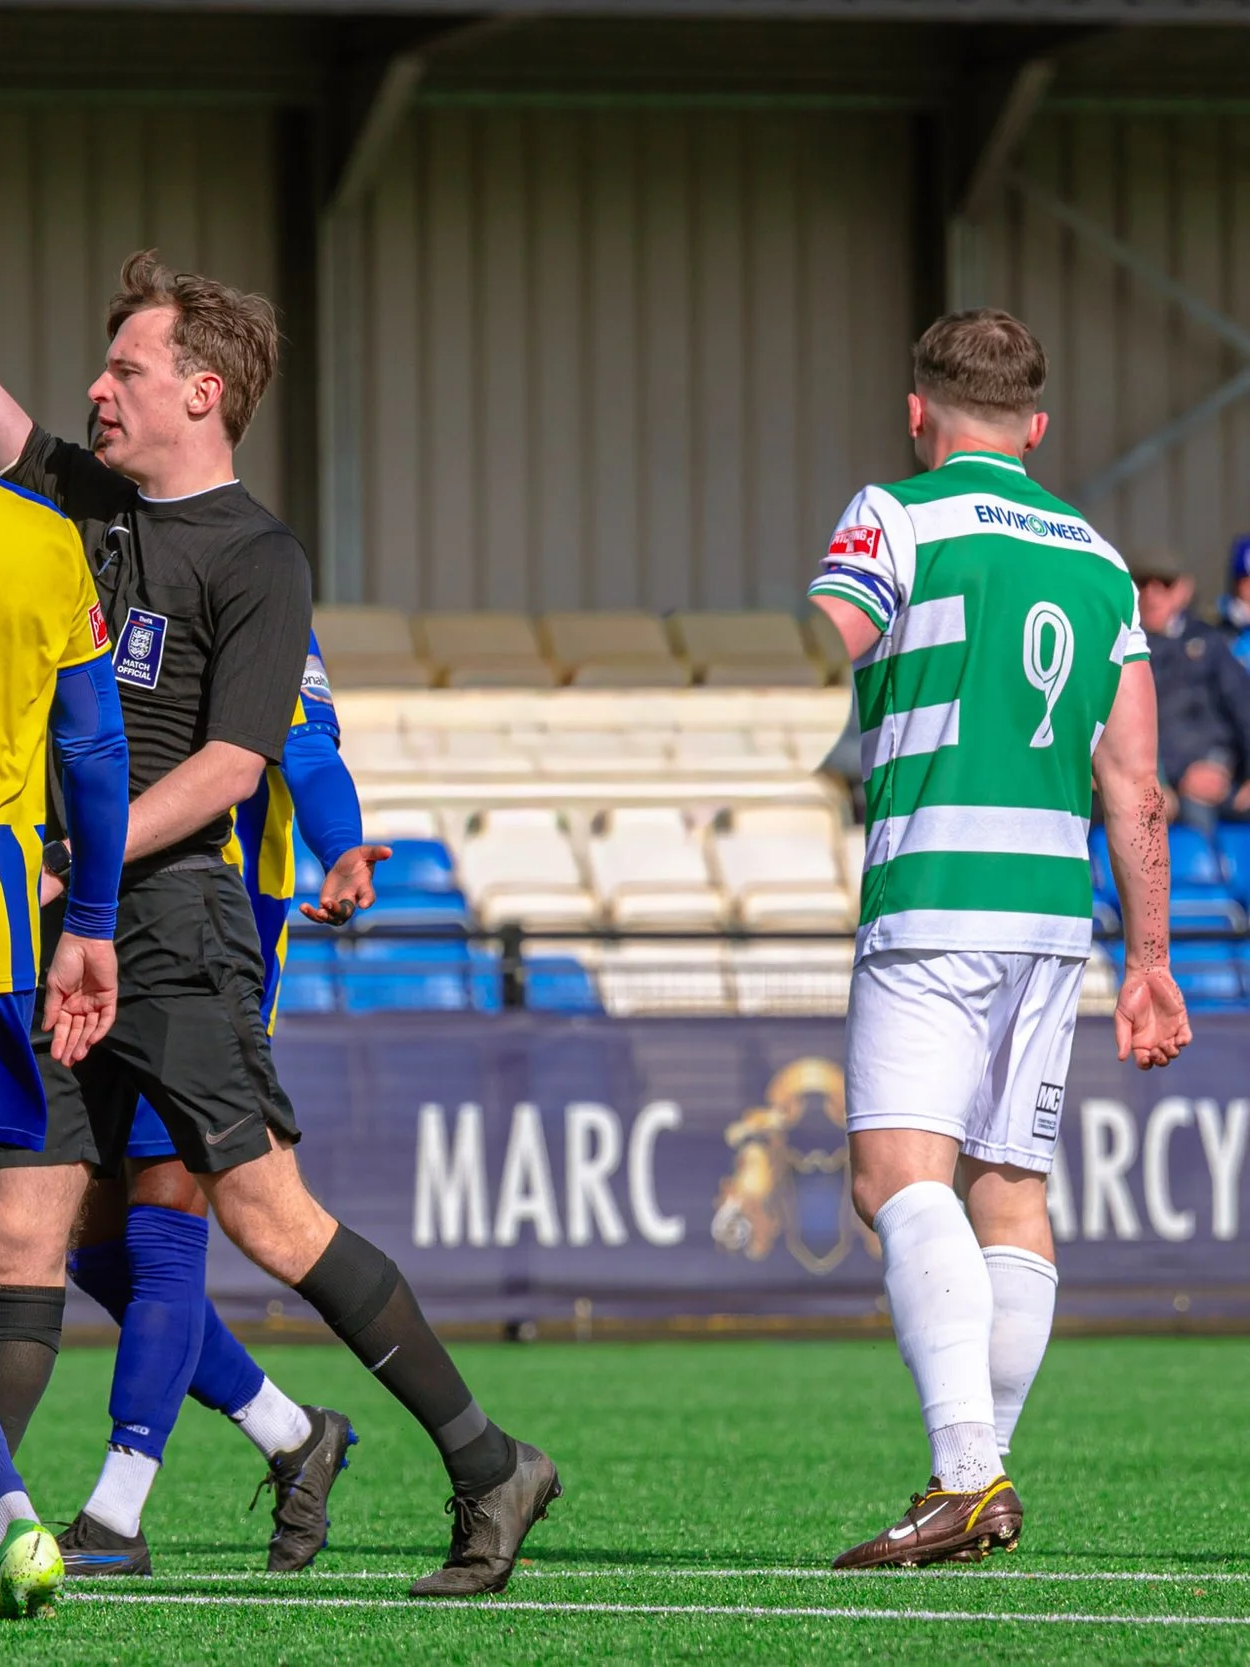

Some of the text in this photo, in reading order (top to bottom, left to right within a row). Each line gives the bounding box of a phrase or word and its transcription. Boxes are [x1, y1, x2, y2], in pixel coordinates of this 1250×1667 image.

[117, 665, 152, 681] OFFICIAL
[122, 658, 151, 672] MATCH
[1022, 601, 1075, 748] 9
[1037, 1085, 1061, 1112] MC
[413, 1101, 685, 1247] MARC
